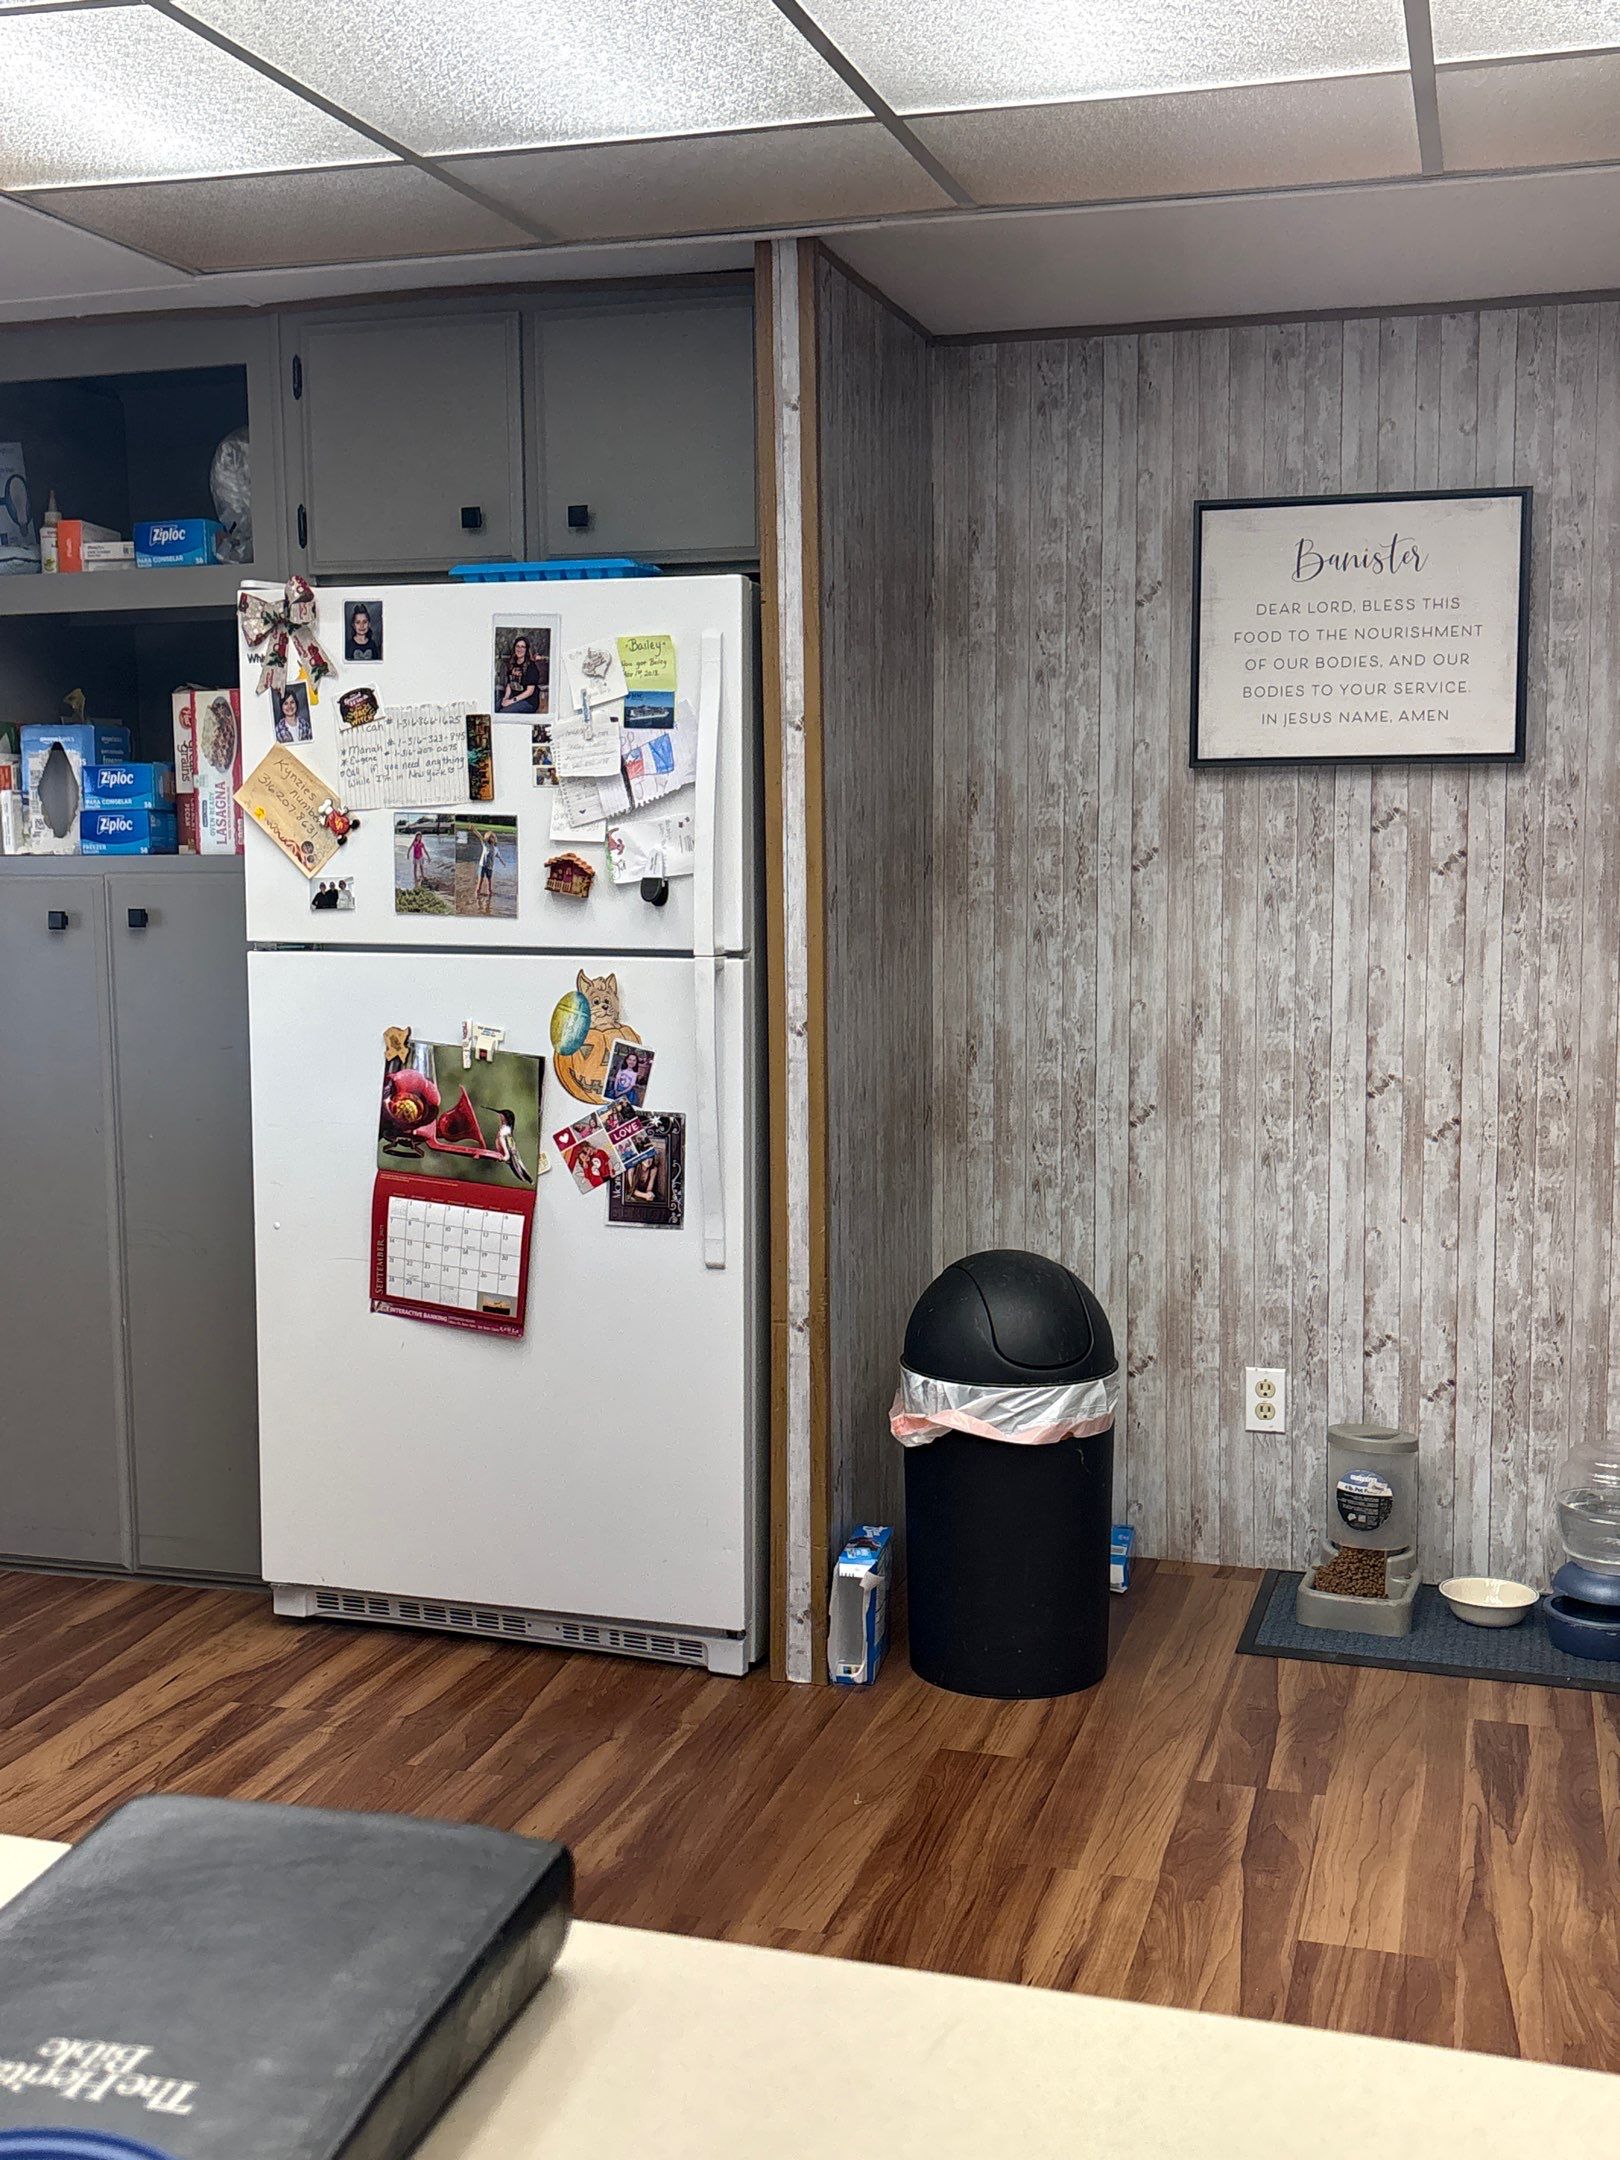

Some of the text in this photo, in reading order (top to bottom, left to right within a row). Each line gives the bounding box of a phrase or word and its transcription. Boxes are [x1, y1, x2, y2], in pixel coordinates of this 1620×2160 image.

[153, 528, 186, 545] Ziploc
[1291, 532, 1430, 583] Banister
[1256, 596, 1461, 616] DEAR LORD, BLESS THIS
[1234, 624, 1484, 644] FOOD TO THE NOURISHMENT
[628, 639, 661, 656] Bailey
[1244, 652, 1470, 671] OF OUR BODIES, AND OUR
[1242, 680, 1471, 699] BODIES TO YOUR SERVICE.
[1261, 709, 1449, 728] IN JESUS NAME, AMEN
[350, 756, 377, 766] Eugene
[385, 764, 398, 775] you
[402, 758, 420, 769] need
[426, 755, 464, 769] anything
[101, 771, 134, 788] Ziploc
[273, 759, 318, 801] Kynzies
[215, 780, 227, 845] LASAGNA
[100, 818, 133, 835] Ziploc
[613, 1122, 639, 1141] LOVE
[423, 1313, 448, 1322] BANKING
[36, 2037, 154, 2074] Bible
[115, 2072, 199, 2115] The
